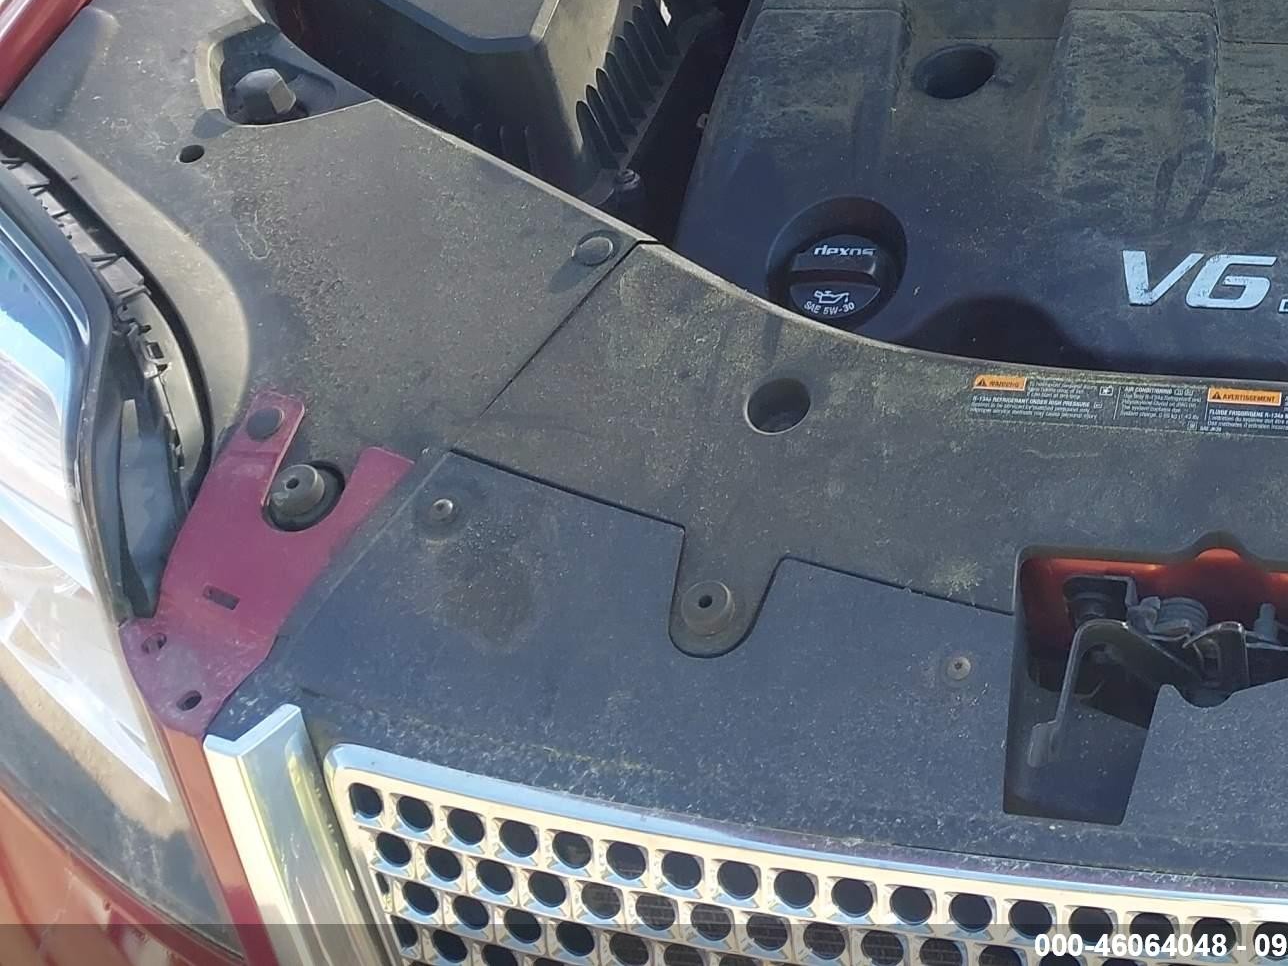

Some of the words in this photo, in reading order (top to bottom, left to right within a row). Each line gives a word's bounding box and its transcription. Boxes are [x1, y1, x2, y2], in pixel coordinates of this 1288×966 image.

[1121, 249, 1278, 310] V6
[804, 300, 821, 315] SAE
[823, 301, 855, 316] 5W-30
[1222, 394, 1275, 402] AVERTISSEMENT
